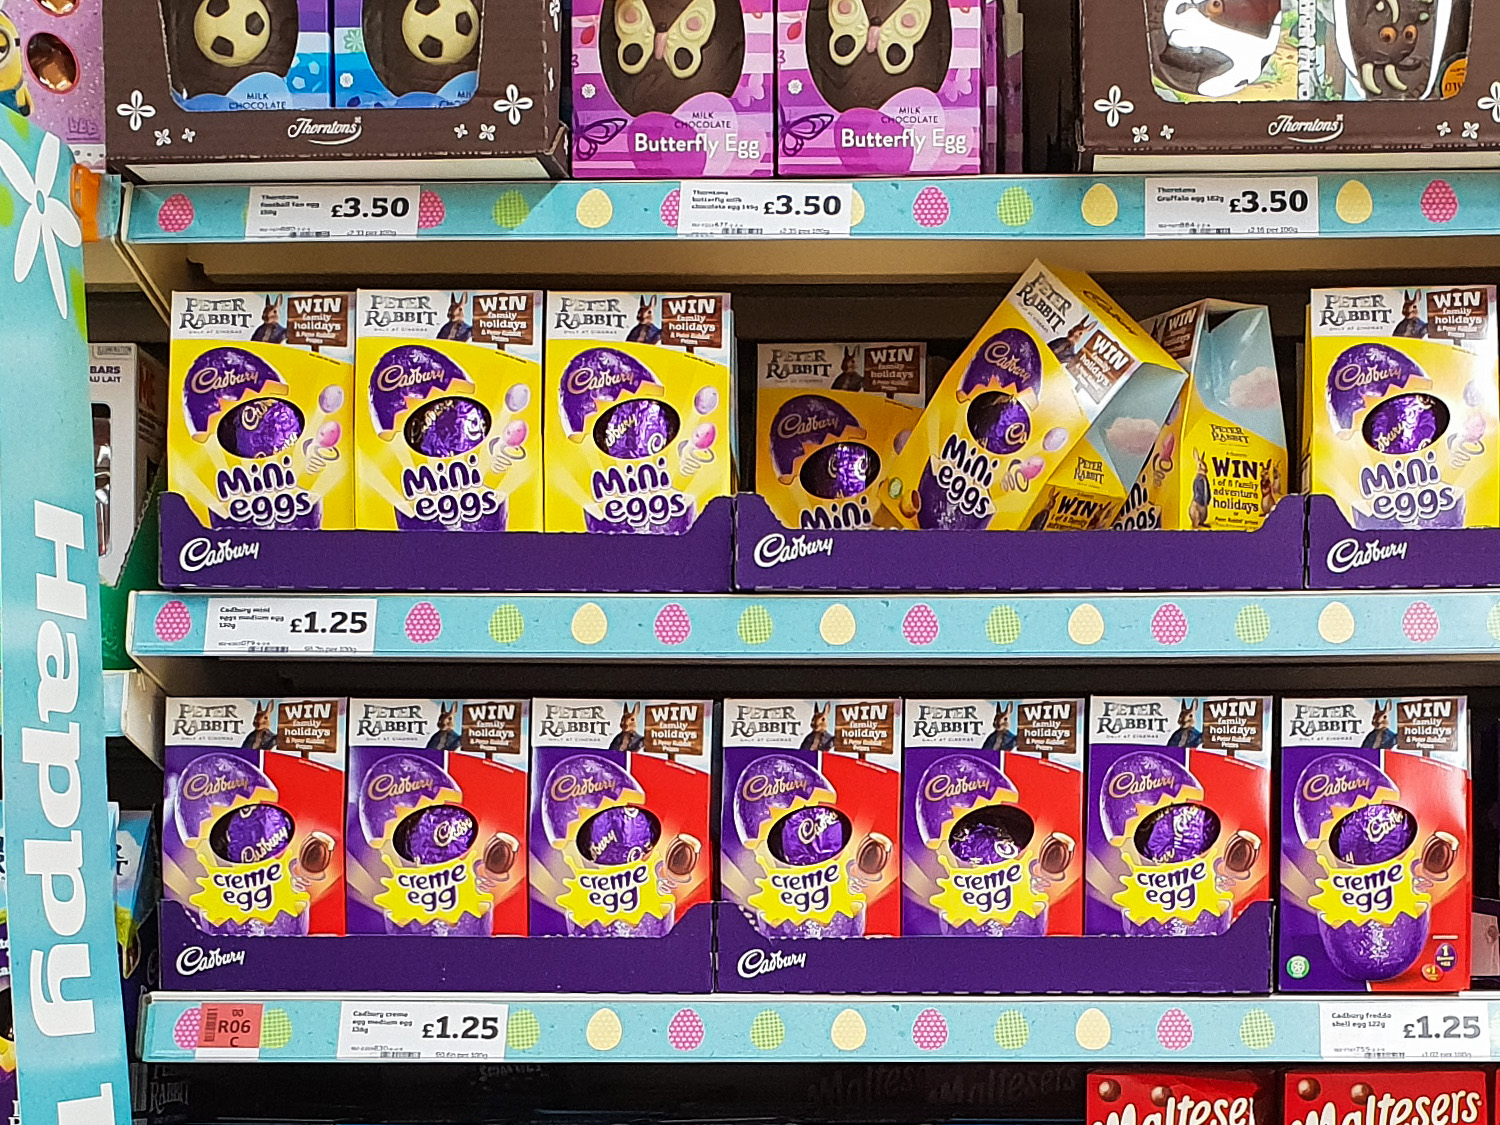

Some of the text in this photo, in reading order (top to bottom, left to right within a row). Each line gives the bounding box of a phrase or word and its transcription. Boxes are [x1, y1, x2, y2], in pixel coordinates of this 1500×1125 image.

[288, 117, 362, 144] Thorntons
[841, 129, 967, 153] Butterfly Egg
[634, 133, 760, 160] Butterfly Egg
[331, 198, 410, 218] £3.50
[763, 195, 841, 216] £3.50
[1229, 190, 1308, 214] £3.50
[185, 297, 246, 313] PETER
[294, 298, 341, 314] WIN
[179, 312, 252, 330] RABBIT
[294, 321, 341, 333] holidays
[191, 367, 258, 394] Cadbury
[217, 456, 296, 499] Mini
[403, 455, 481, 498] Mini
[1361, 452, 1439, 493] Mini
[229, 491, 311, 524] eggs
[415, 489, 497, 523] eggs
[1374, 487, 1454, 519] eggs
[180, 537, 260, 571] Cadbury
[754, 534, 834, 567] Cadbury
[1326, 539, 1407, 572] Cadbury
[290, 612, 367, 634] £1.25
[1294, 703, 1354, 719] PETER
[1408, 702, 1453, 719] WIN
[1289, 718, 1361, 736] RABBIT
[1404, 726, 1452, 738] holidays
[21, 500, 96, 1037] Happy
[1303, 773, 1369, 800] Cadbury
[213, 863, 282, 889] creme
[1332, 863, 1402, 890] creme
[223, 885, 272, 911] egg
[1343, 885, 1392, 911] egg
[176, 946, 245, 976] Cadbury
[737, 949, 807, 978] Cadbury
[218, 1019, 251, 1034] R06
[422, 1016, 499, 1040] £1.25
[1332, 1012, 1361, 1020] Cadbury
[1403, 1016, 1480, 1039] £1.25
[230, 1036, 239, 1047] C
